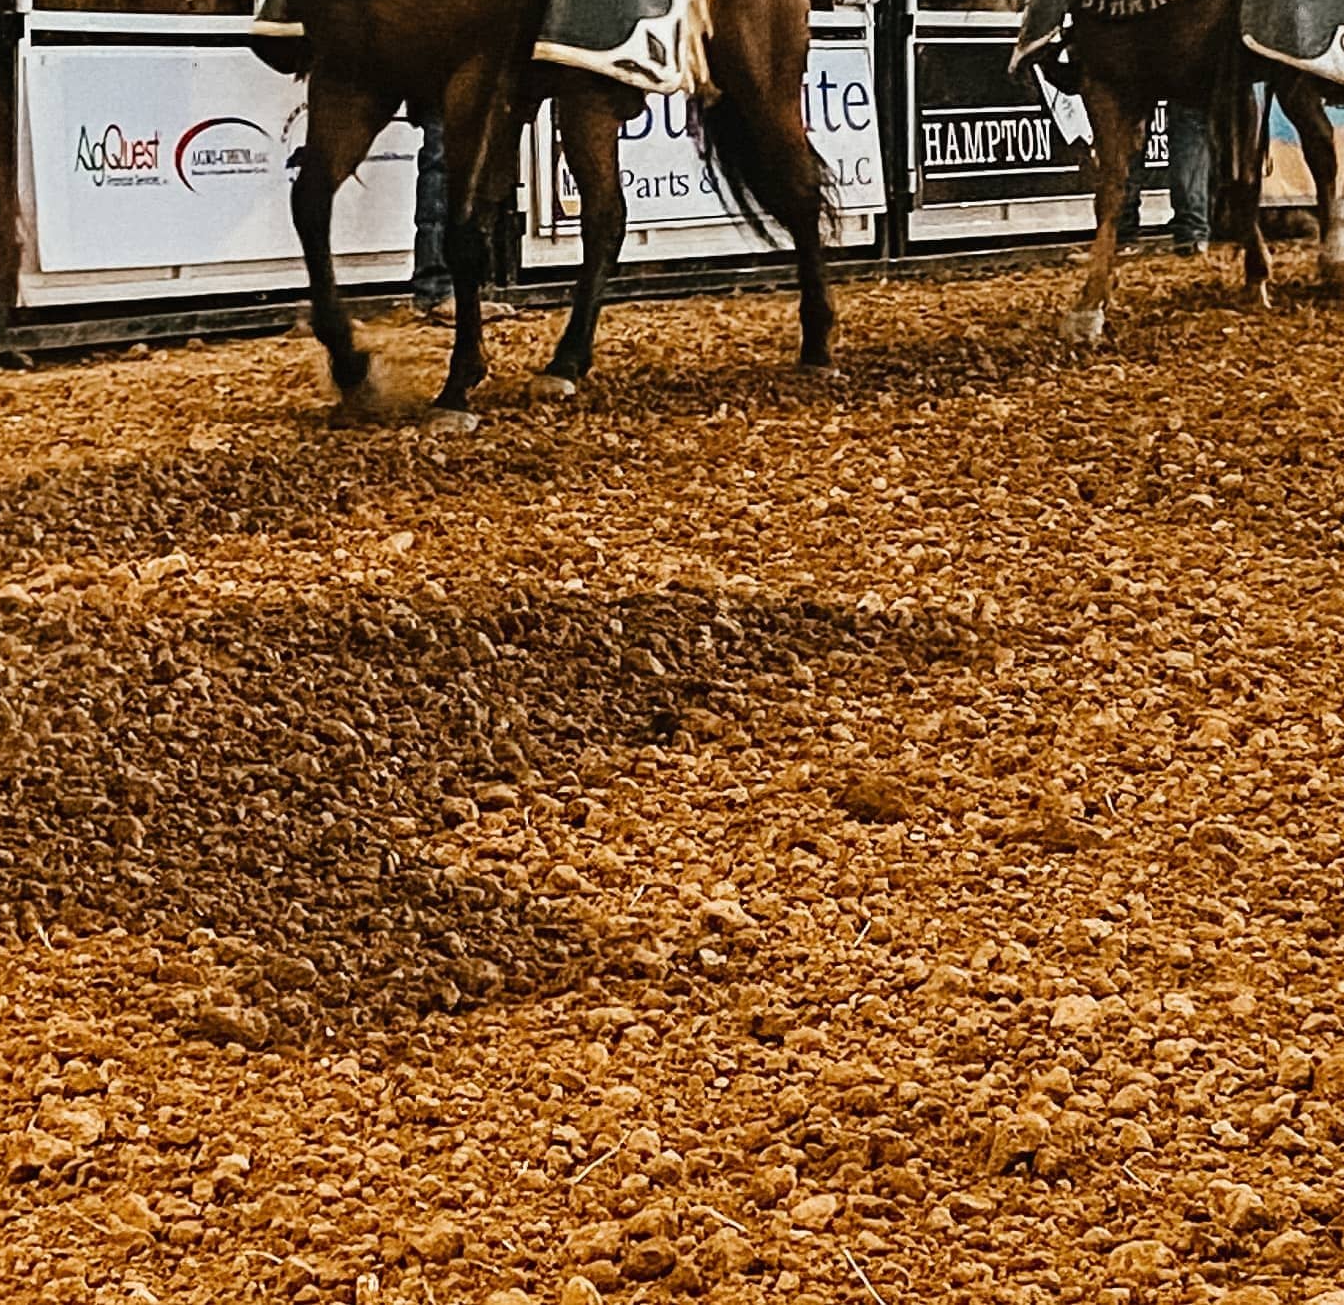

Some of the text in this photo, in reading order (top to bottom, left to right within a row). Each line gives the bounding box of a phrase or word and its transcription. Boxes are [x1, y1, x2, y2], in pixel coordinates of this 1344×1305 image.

[74, 124, 160, 187] AgQuest
[922, 117, 1052, 166] HAMPTON
[619, 169, 690, 198] Parts
[837, 156, 872, 186] LC
